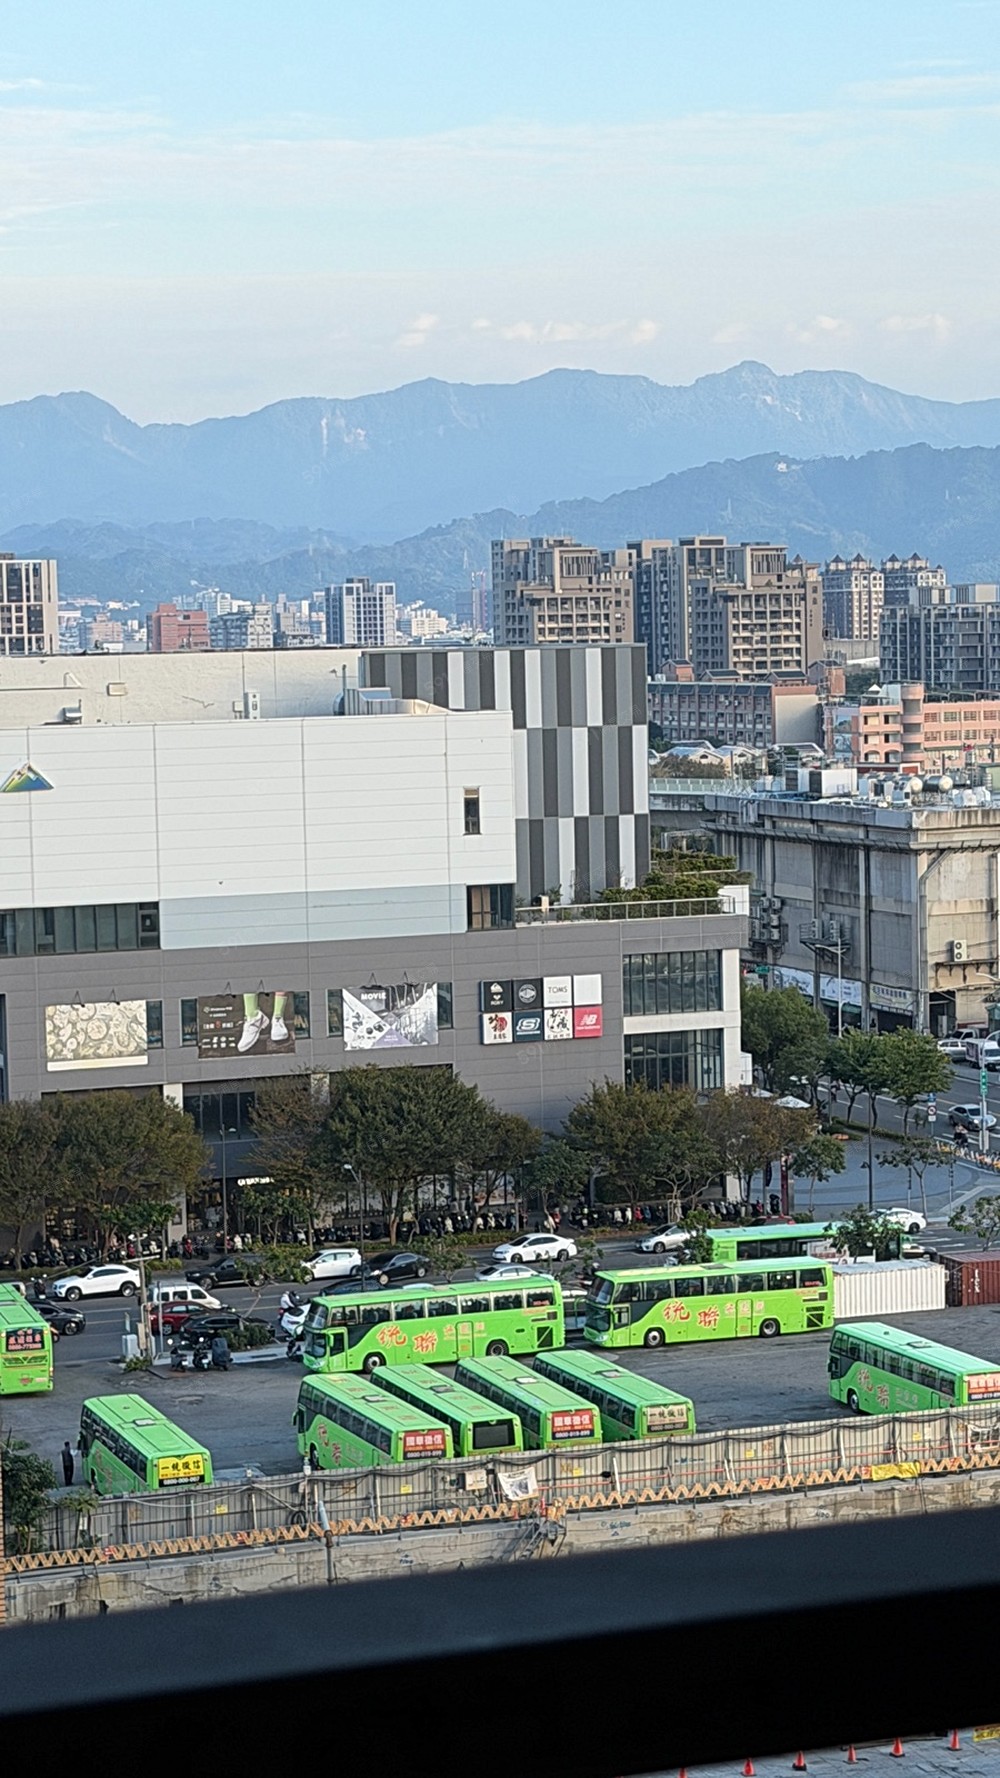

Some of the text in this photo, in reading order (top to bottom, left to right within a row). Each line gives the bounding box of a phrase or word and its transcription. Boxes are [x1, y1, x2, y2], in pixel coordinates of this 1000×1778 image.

[548, 986, 568, 994] TOMS
[361, 992, 387, 1000] MOVIE
[161, 1459, 201, 1471] 一統徵信
